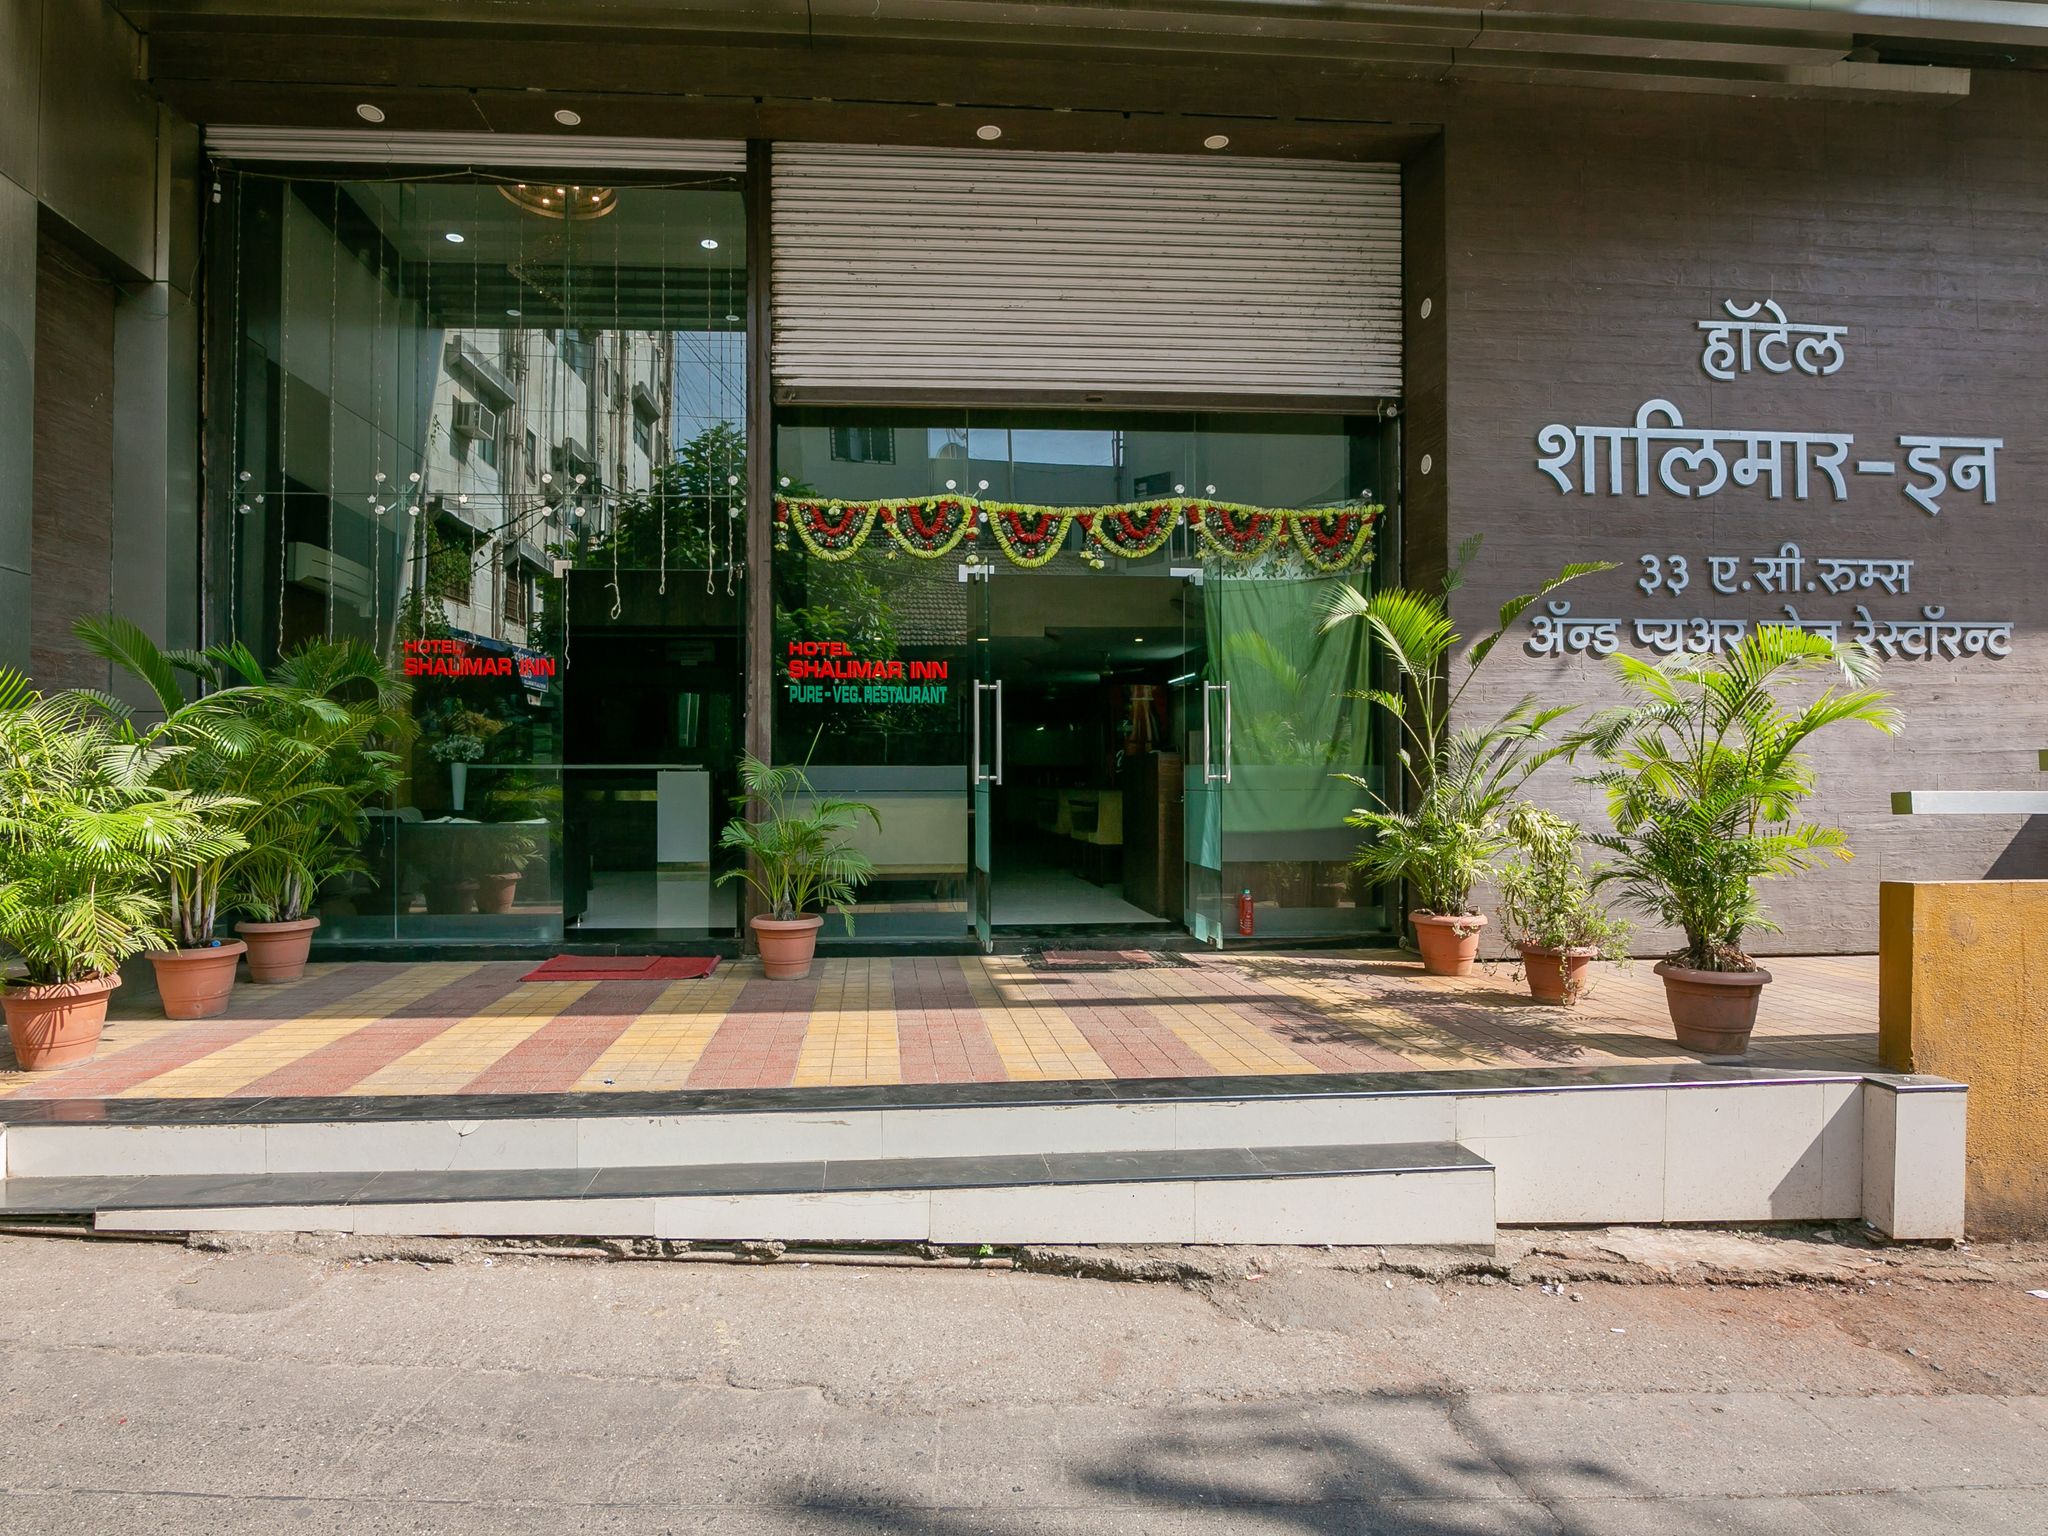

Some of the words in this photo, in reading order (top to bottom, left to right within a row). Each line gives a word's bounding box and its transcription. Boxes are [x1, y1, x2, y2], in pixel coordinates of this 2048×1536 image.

[1698, 299, 1848, 380] हॉटेल
[1637, 553, 1691, 596] ३३
[1853, 604, 2015, 658] रेस्टॉरन्ट
[403, 639, 463, 655] HOTEL
[788, 641, 853, 656] HOTEL
[403, 657, 512, 677] SHALIMAR
[518, 657, 556, 678] INN
[788, 660, 903, 679] SHALIMAR
[909, 661, 948, 679] INN
[864, 685, 948, 704] RESTAURANT
